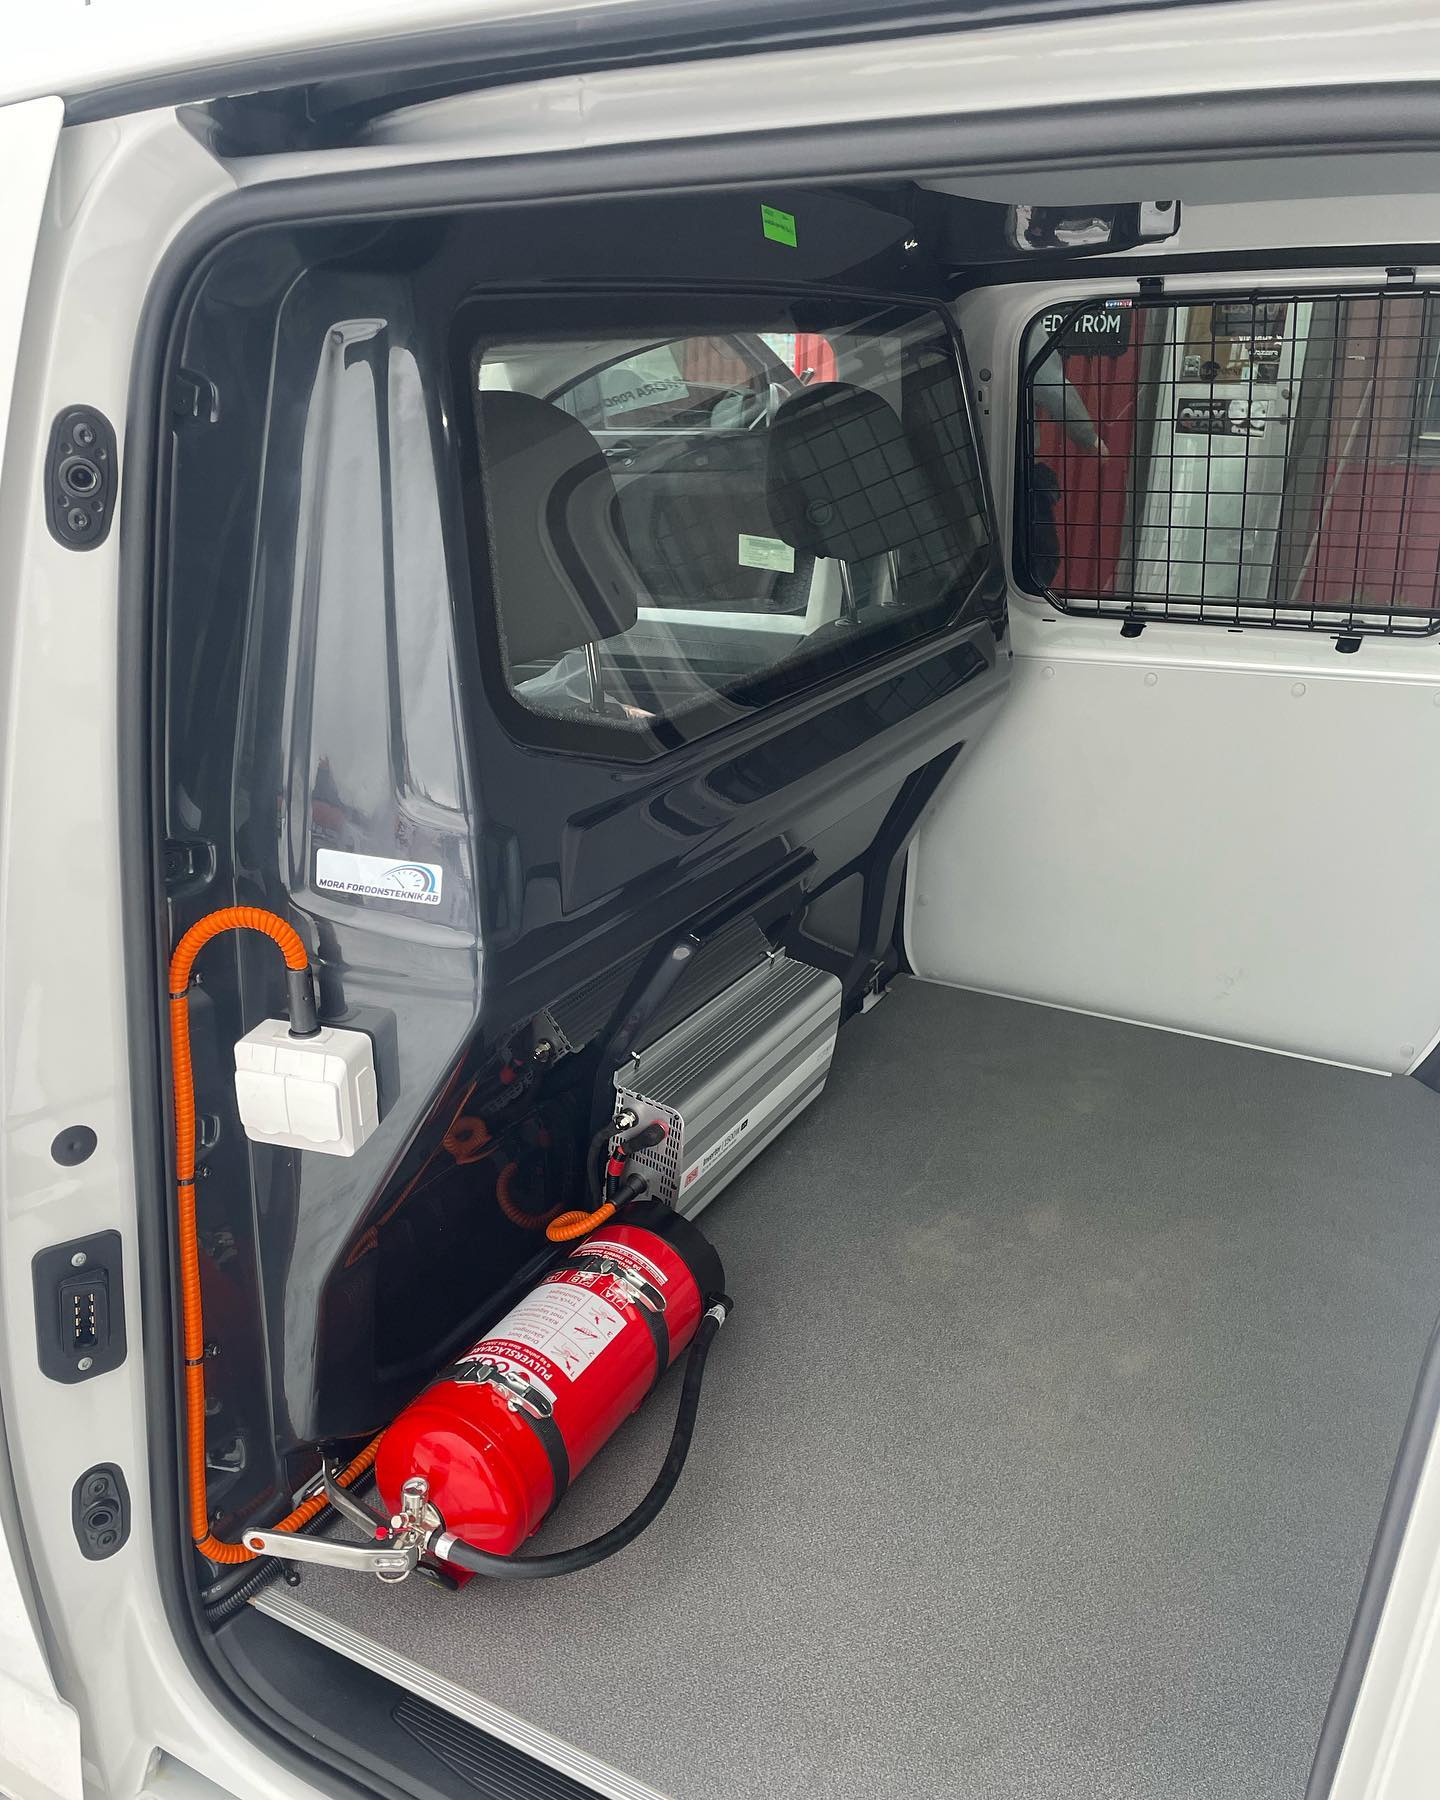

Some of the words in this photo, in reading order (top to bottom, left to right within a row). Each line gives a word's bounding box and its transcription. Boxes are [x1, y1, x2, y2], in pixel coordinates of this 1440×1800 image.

[318, 878, 345, 889] MORA
[346, 883, 424, 900] FORDONSTEKNIK
[425, 894, 439, 902] AB
